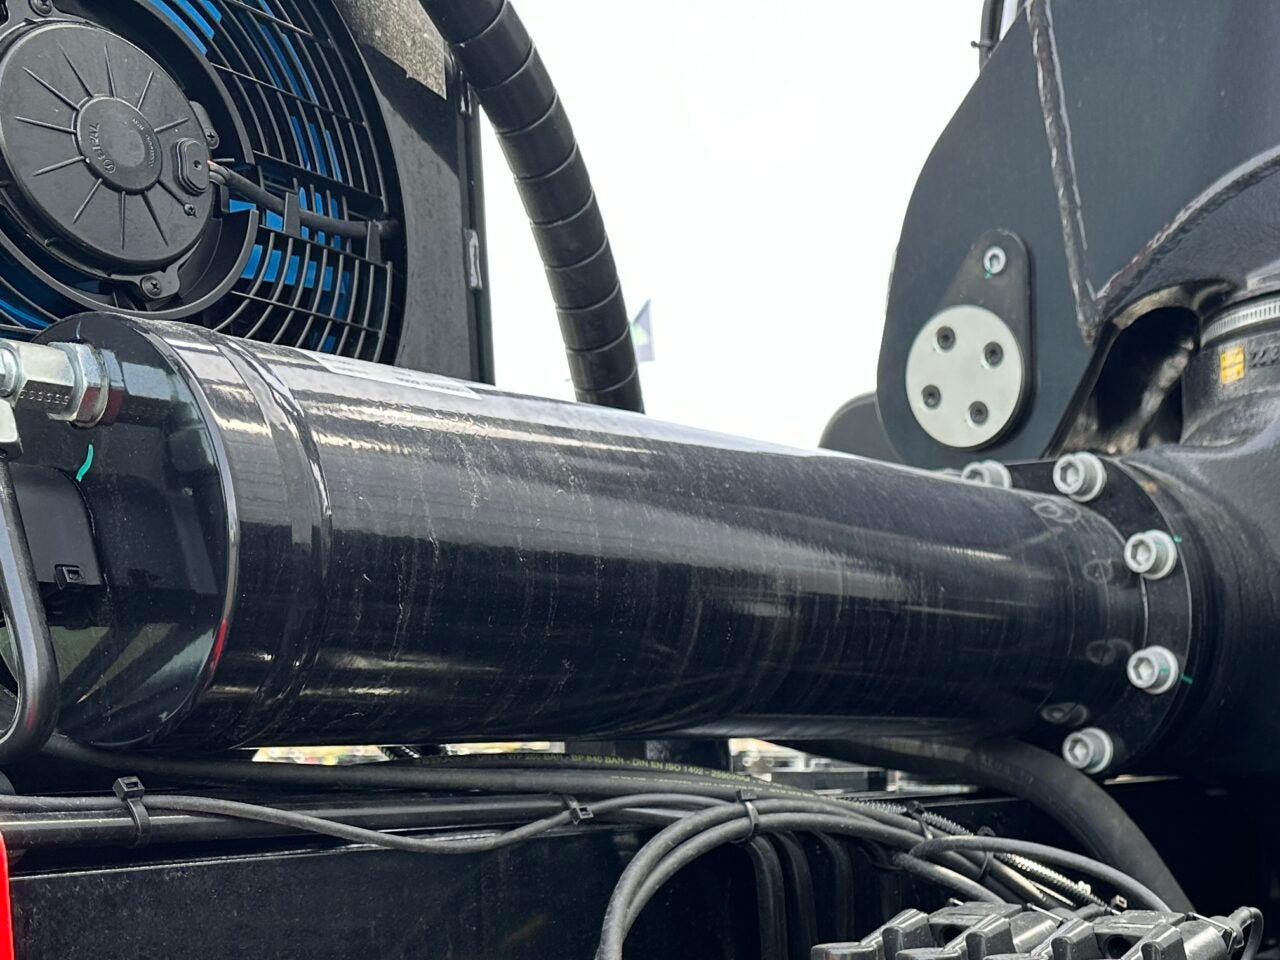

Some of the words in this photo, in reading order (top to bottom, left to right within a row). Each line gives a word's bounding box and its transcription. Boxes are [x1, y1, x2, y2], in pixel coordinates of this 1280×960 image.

[604, 756, 625, 766] BAR
[631, 758, 649, 768] DIN
[650, 760, 664, 770] EN
[664, 762, 682, 772] ISO
